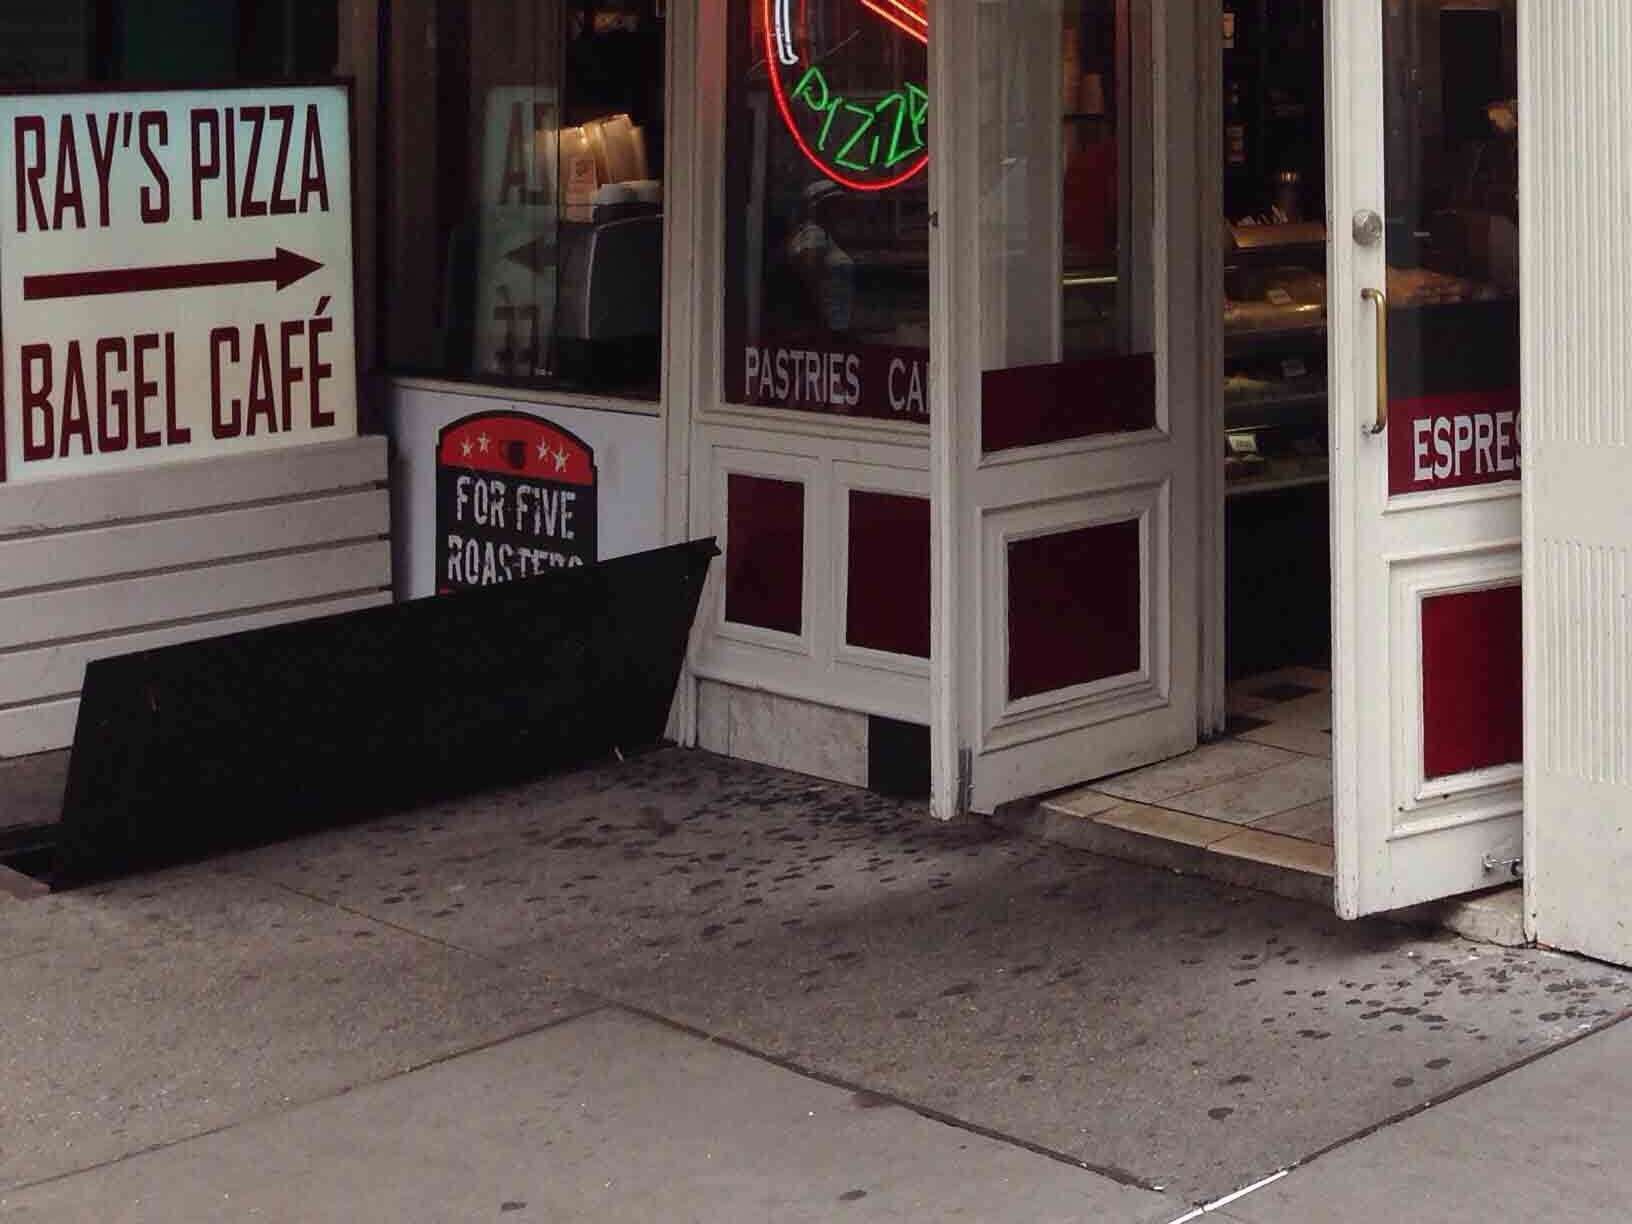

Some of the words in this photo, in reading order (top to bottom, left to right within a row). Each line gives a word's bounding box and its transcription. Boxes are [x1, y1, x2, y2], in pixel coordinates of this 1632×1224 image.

[14, 110, 169, 232] RAY'S
[190, 104, 330, 221] PIZZA
[20, 332, 191, 463] BAGEL
[210, 295, 335, 439] CAFÉ
[744, 345, 861, 406] PASTRIES
[888, 358, 930, 414] CA
[456, 476, 505, 528] FOR
[515, 484, 577, 540] FIVE
[447, 534, 584, 586] ROASTE
